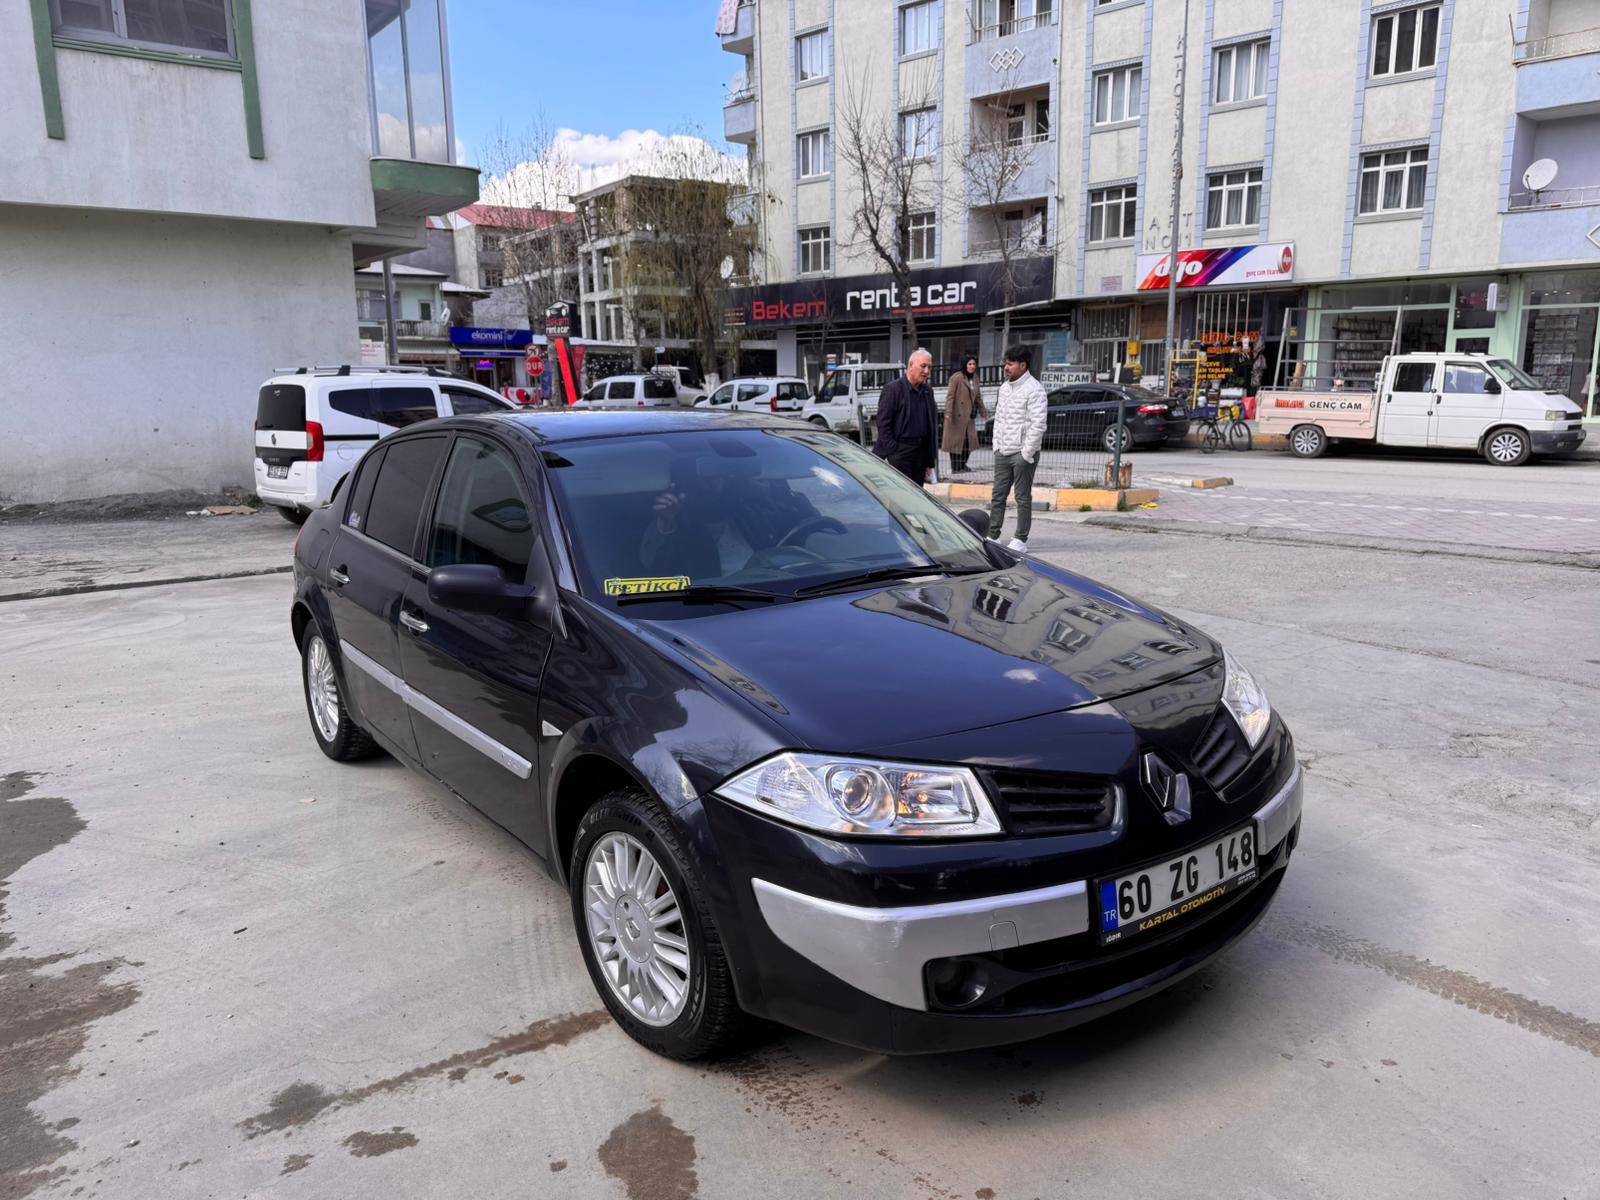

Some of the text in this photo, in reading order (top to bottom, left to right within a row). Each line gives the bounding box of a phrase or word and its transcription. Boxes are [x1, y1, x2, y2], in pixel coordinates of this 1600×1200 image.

[752, 299, 827, 320] Bekem
[846, 282, 900, 311] rent
[927, 280, 978, 305] car
[526, 361, 543, 371] DUR
[1067, 374, 1089, 383] CAM
[1309, 401, 1337, 411] GENÇ
[1339, 402, 1362, 410] CAM
[1118, 831, 1253, 920] 60 ZG 148
[1104, 909, 1118, 922] TR
[1139, 909, 1179, 932] KARTAL
